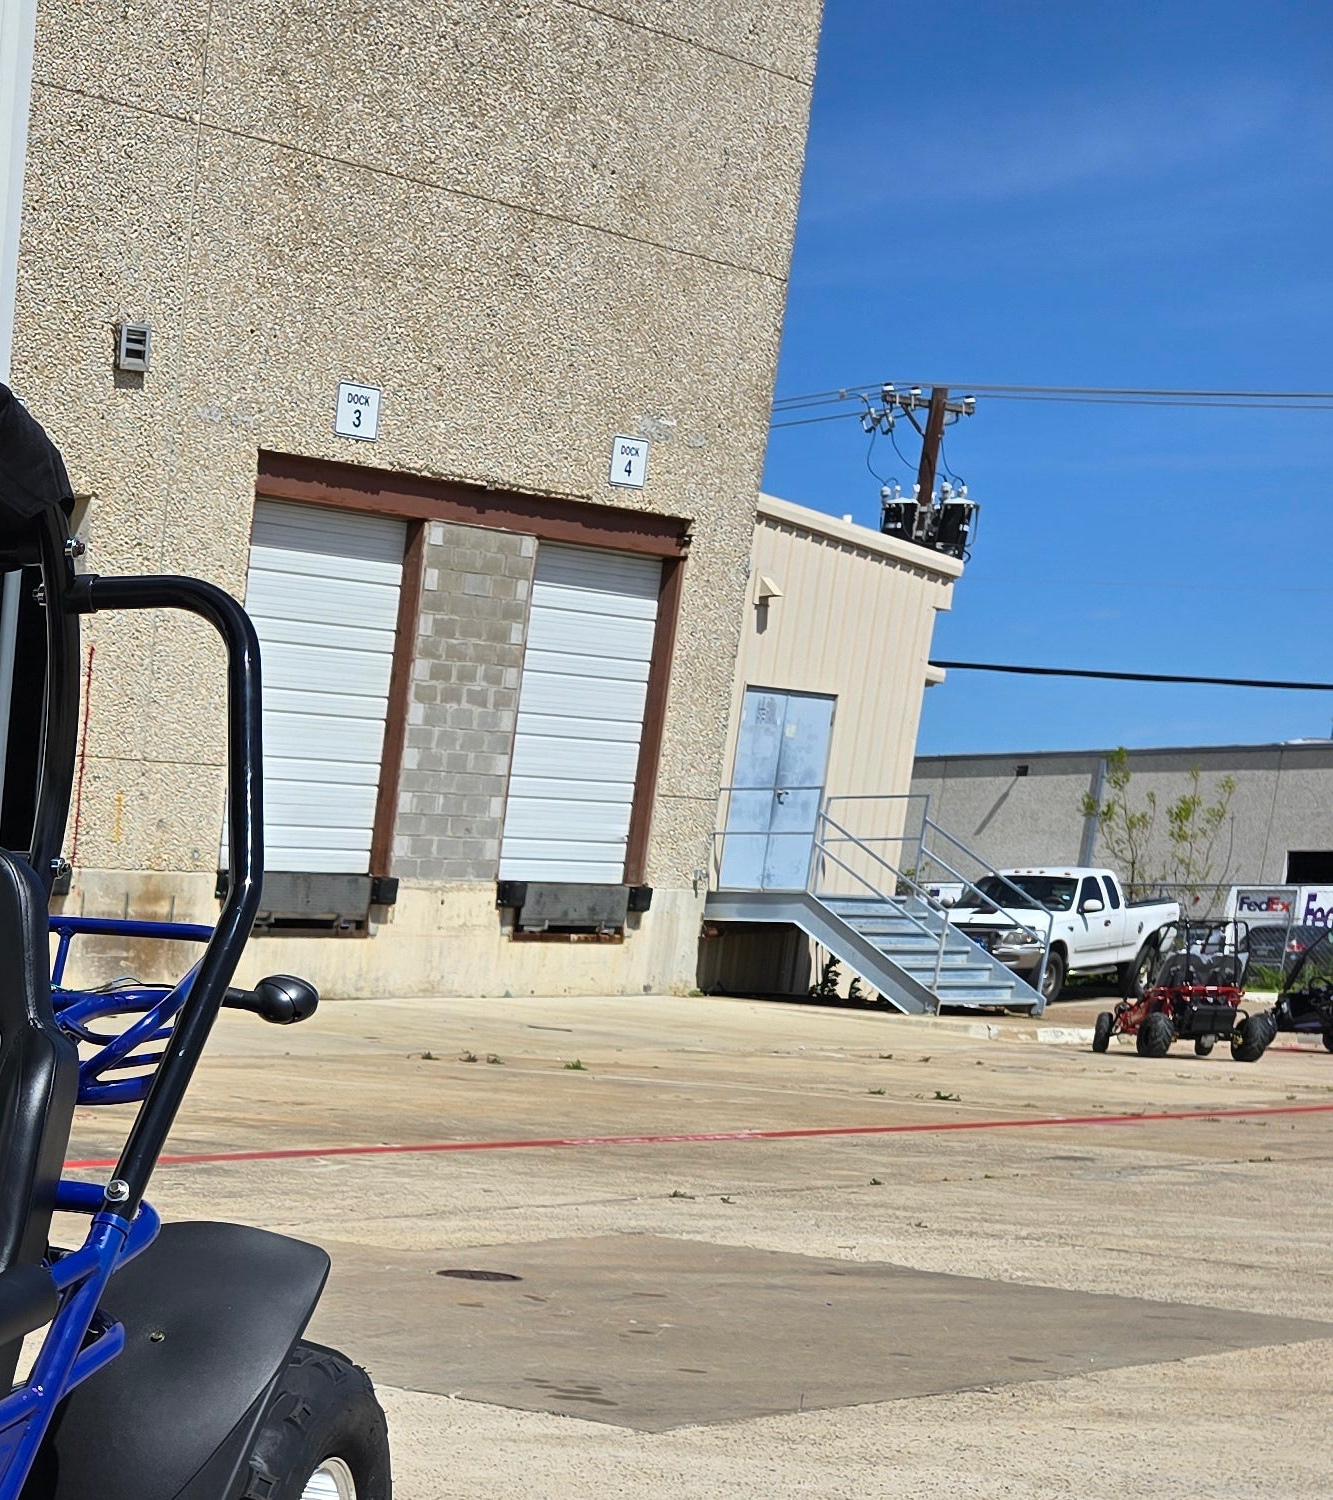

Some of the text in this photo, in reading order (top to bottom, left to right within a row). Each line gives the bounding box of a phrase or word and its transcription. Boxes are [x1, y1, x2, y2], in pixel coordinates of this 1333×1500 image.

[347, 392, 370, 406] DOCK
[352, 409, 362, 428] 3
[620, 444, 640, 457] DOCK
[624, 459, 632, 477] 4
[1238, 896, 1291, 912] FedEx
